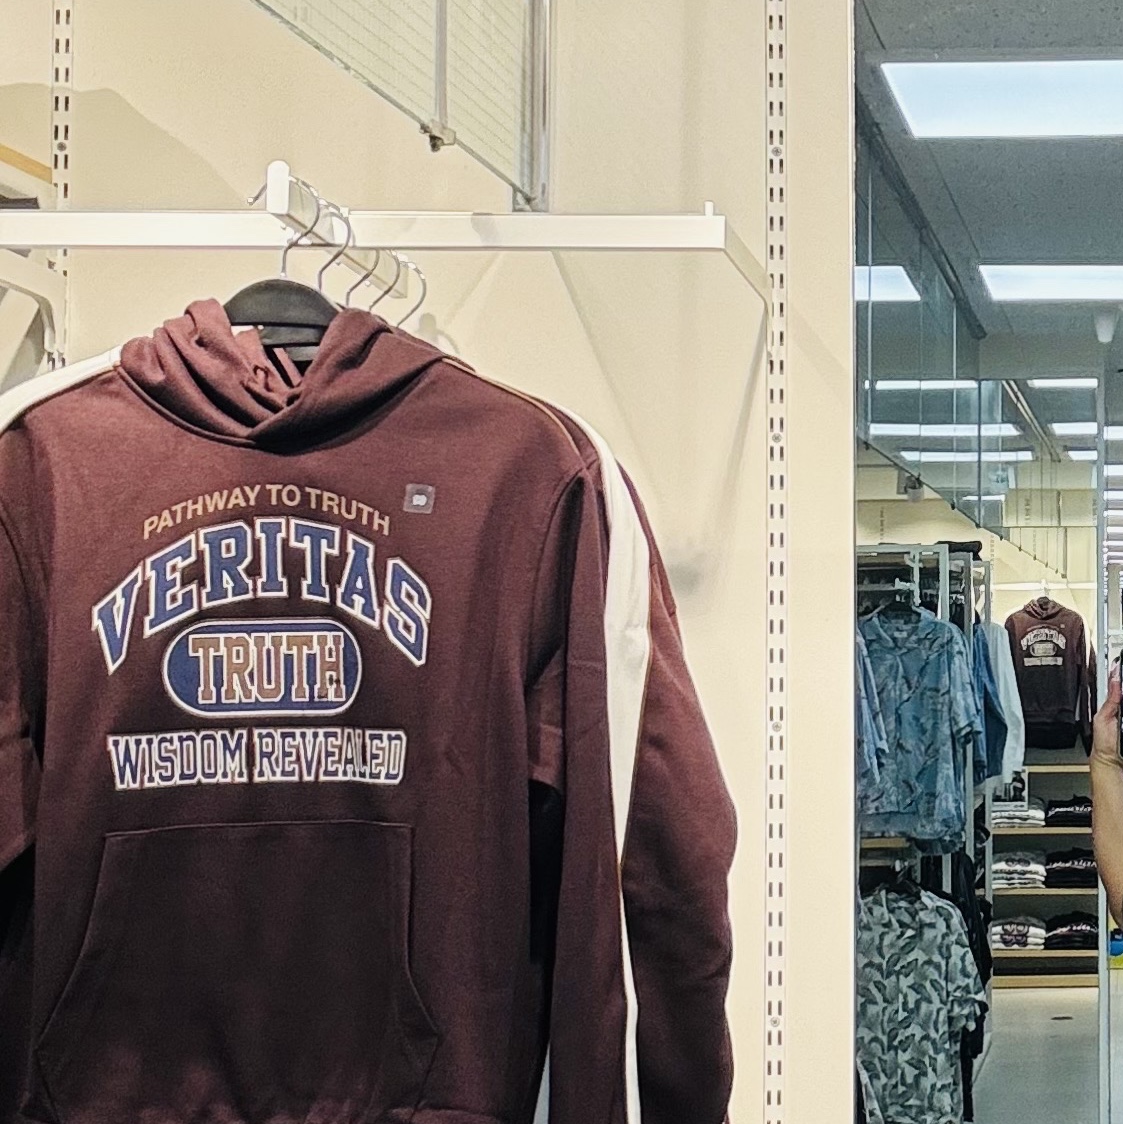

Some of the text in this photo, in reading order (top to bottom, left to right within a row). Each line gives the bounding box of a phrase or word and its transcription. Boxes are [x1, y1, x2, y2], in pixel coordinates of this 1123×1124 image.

[143, 484, 391, 540] PATHWAY TO TRUTH
[91, 515, 432, 676] VERITAS
[188, 631, 346, 705] TRUTH
[106, 728, 408, 790] WISDOM REVEALED
